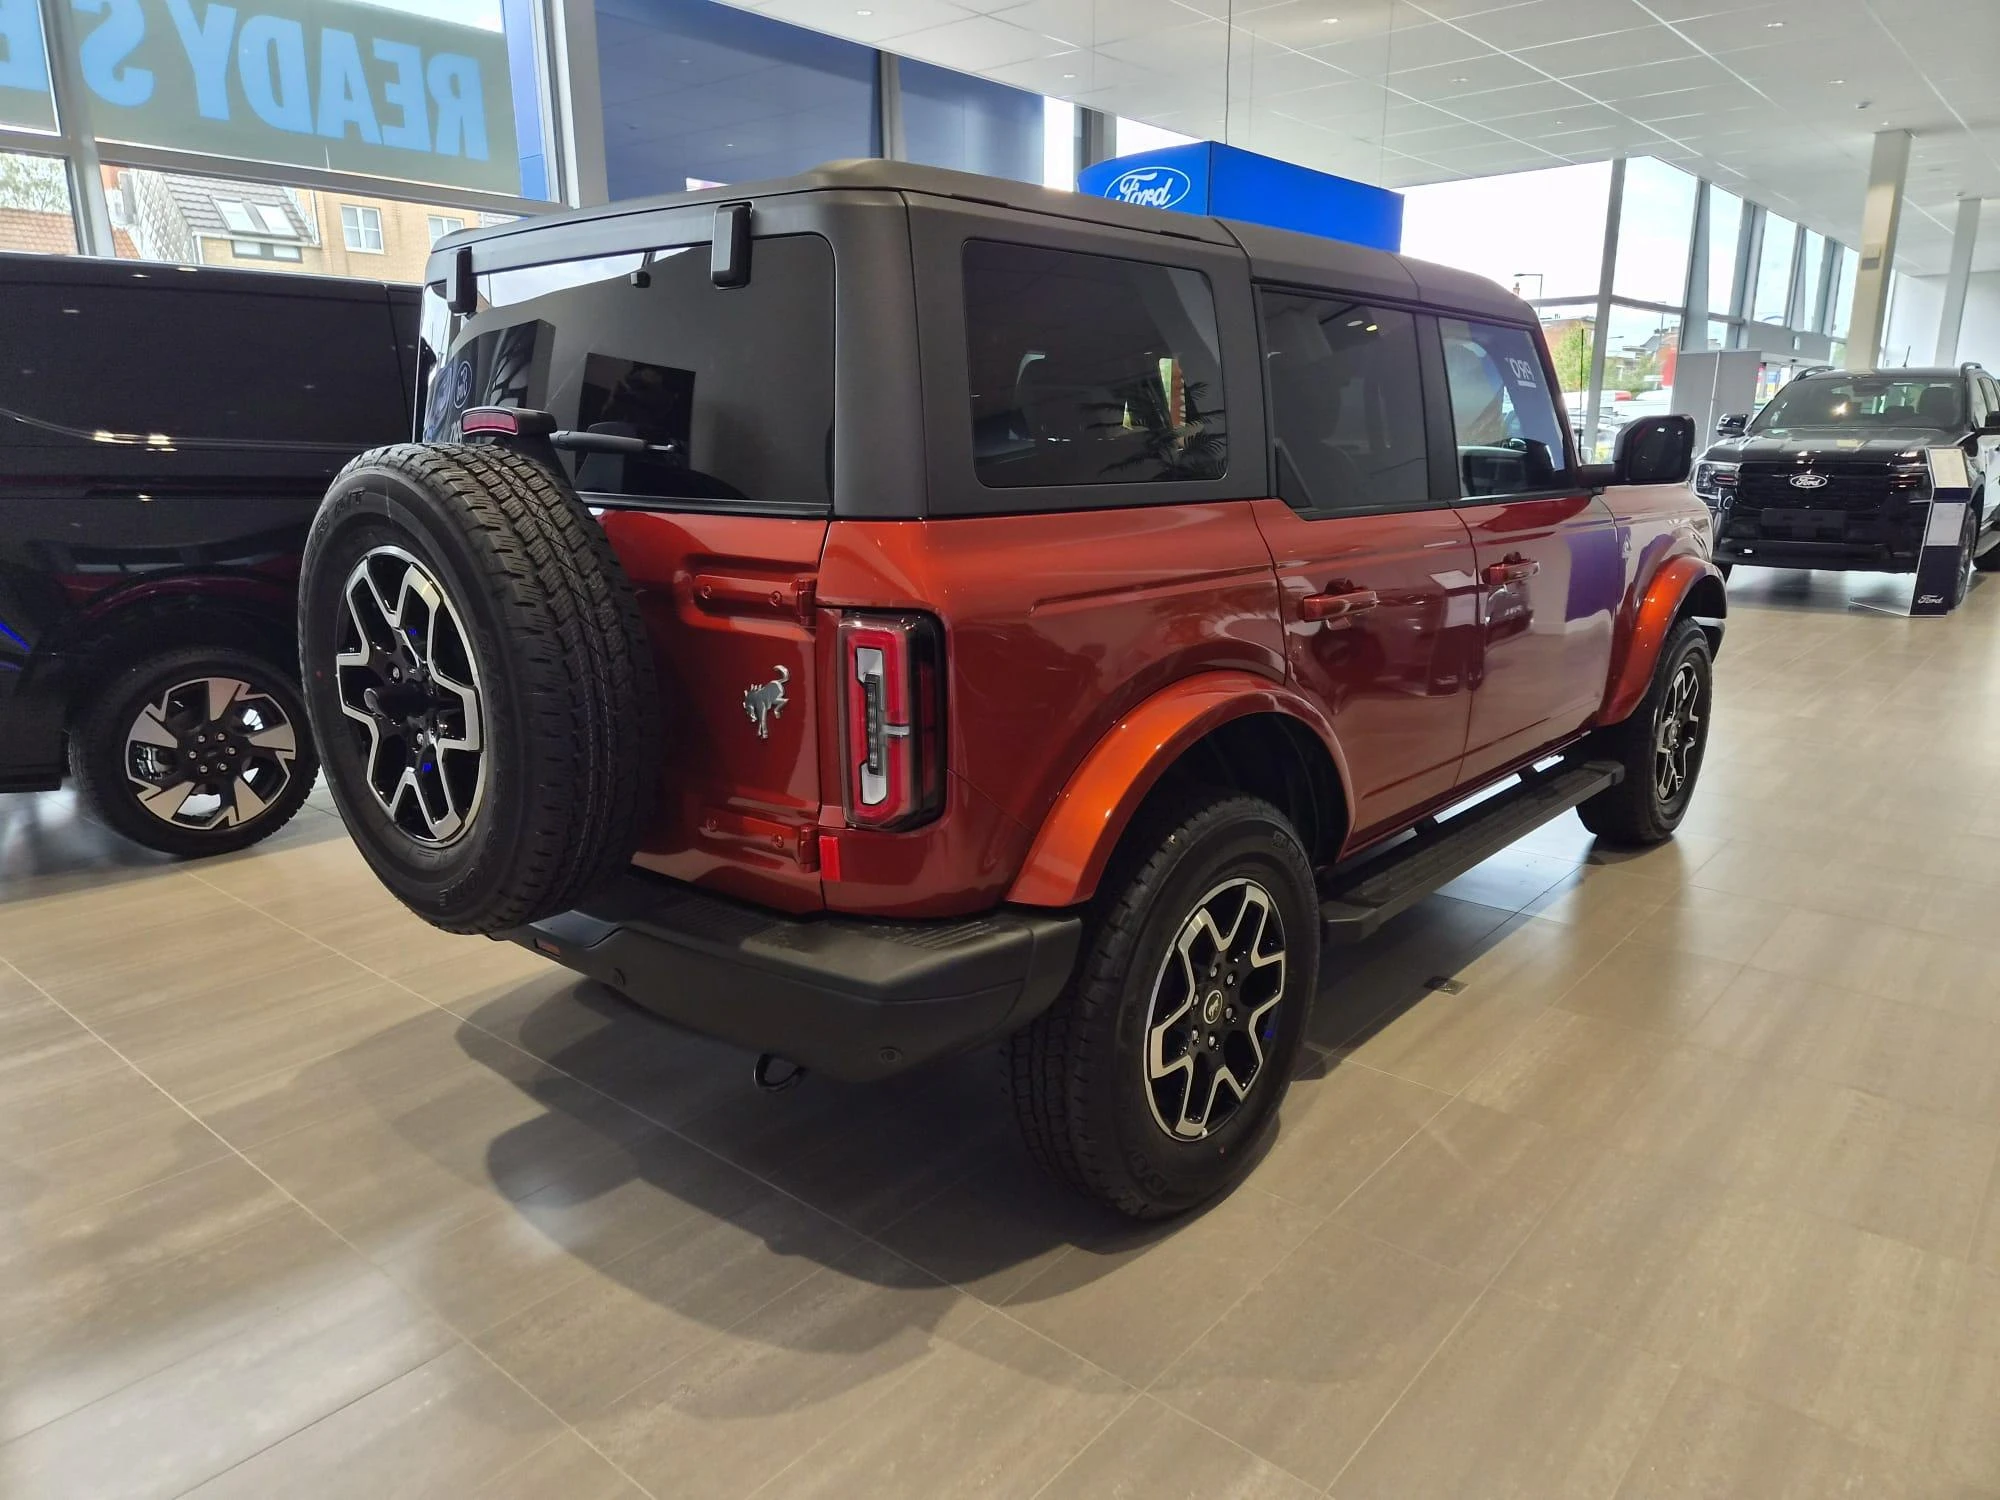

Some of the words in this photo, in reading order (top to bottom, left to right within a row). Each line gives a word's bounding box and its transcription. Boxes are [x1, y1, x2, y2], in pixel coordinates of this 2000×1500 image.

[1115, 172, 1172, 207] Ford
[1796, 475, 1822, 486] Ford
[1917, 594, 1944, 604] Ford
